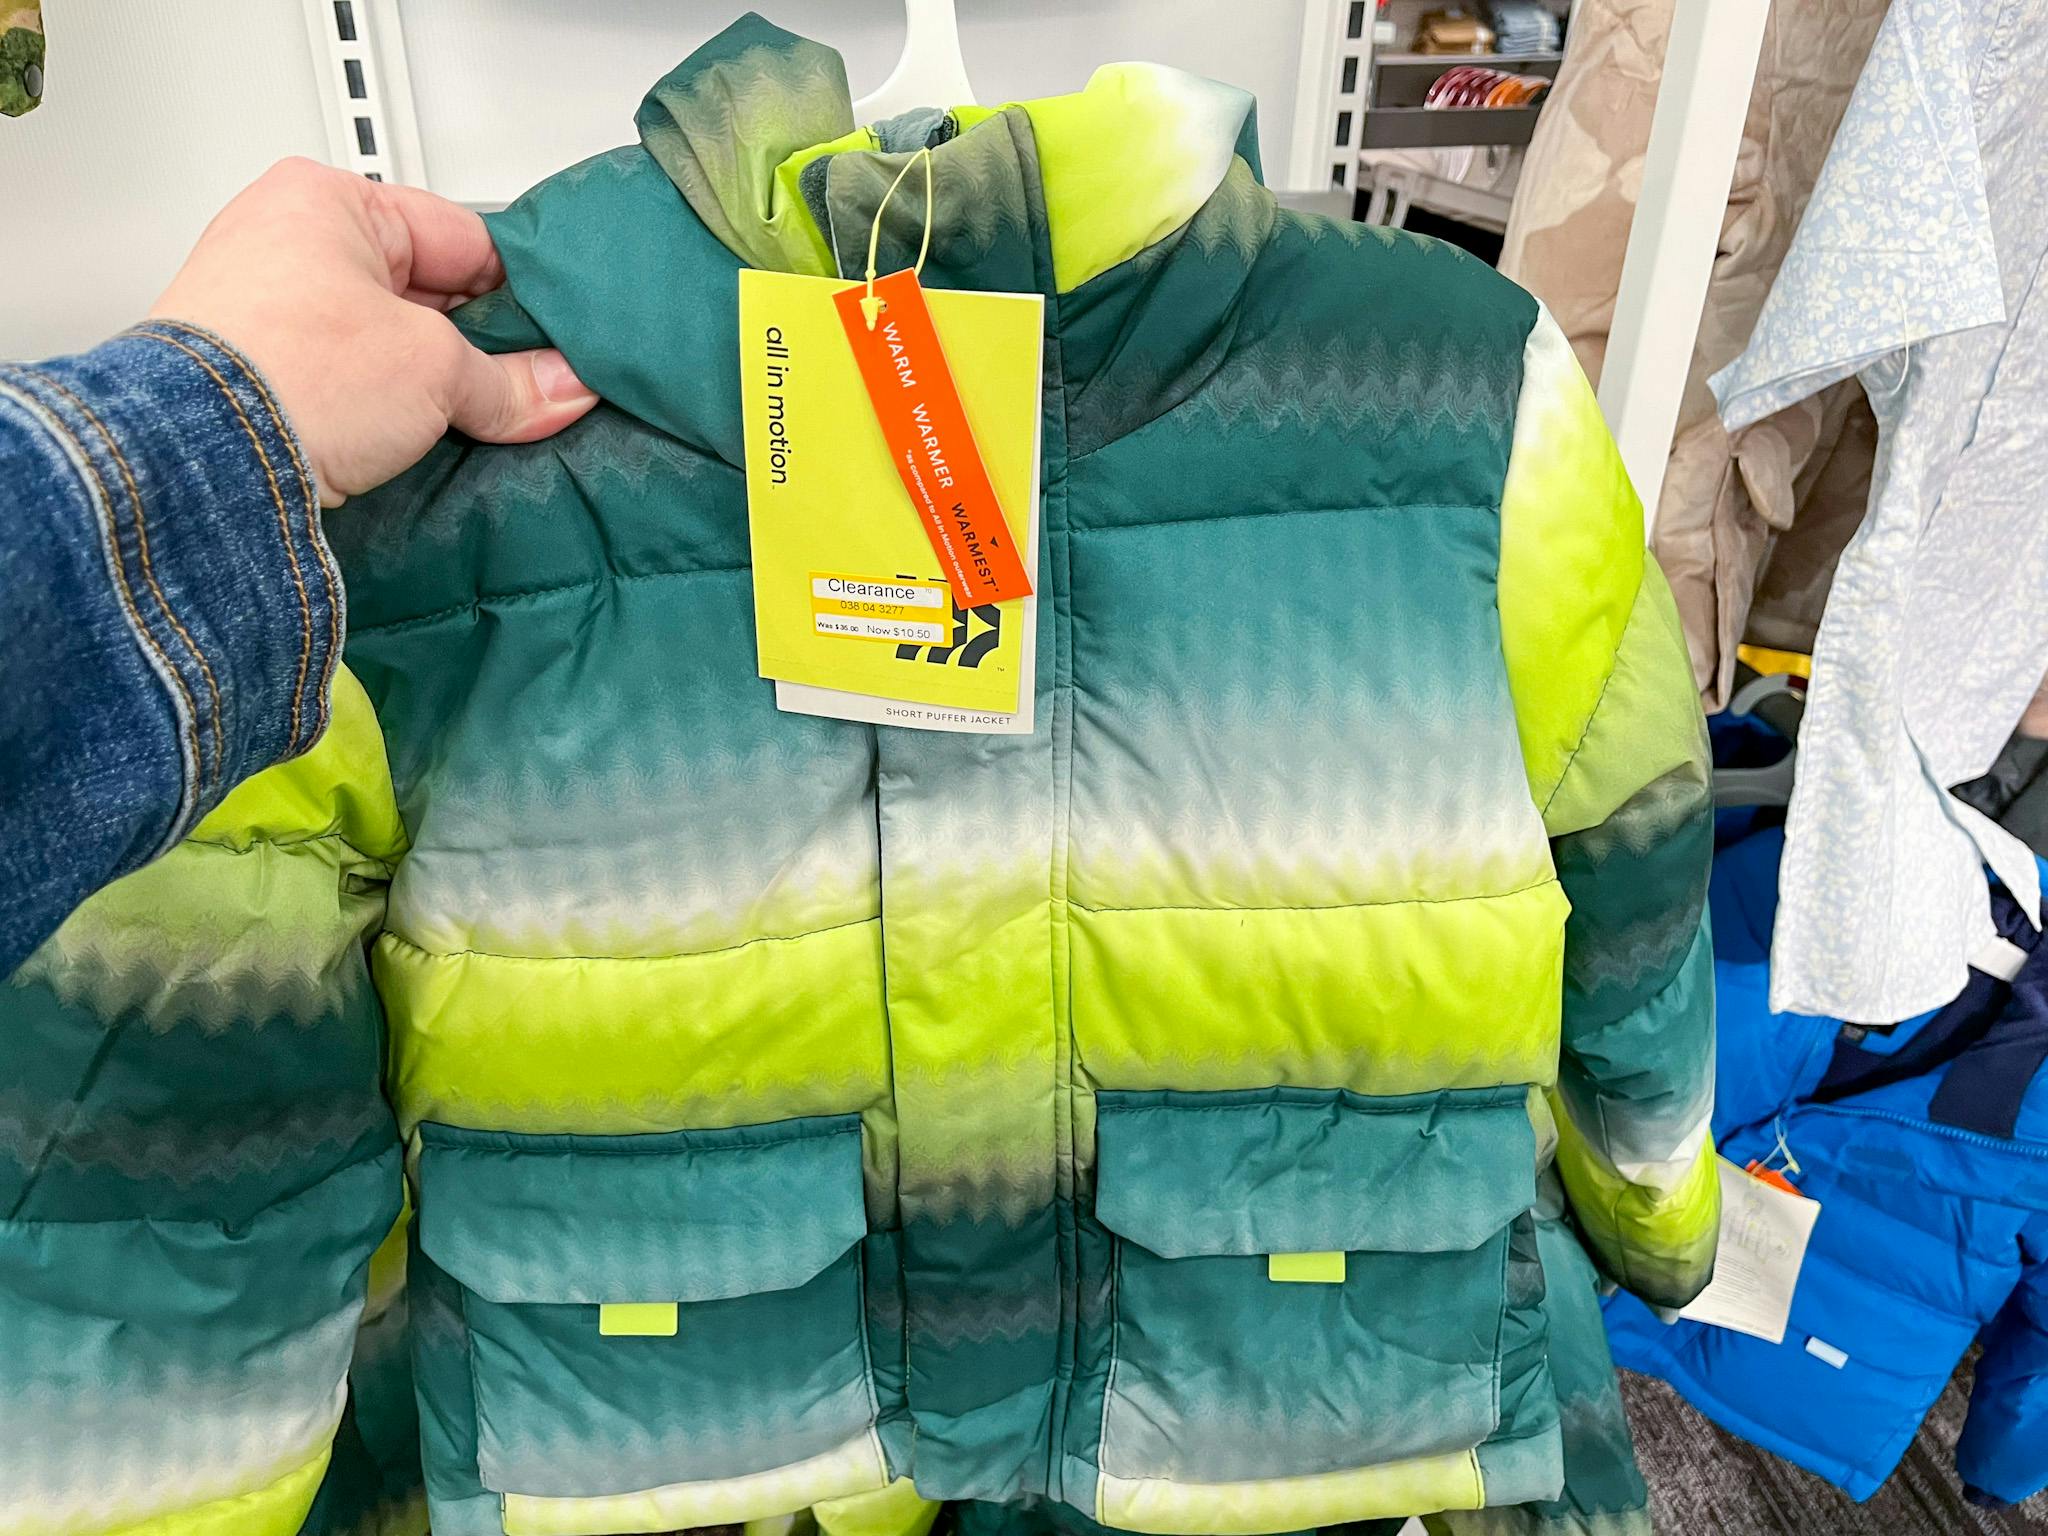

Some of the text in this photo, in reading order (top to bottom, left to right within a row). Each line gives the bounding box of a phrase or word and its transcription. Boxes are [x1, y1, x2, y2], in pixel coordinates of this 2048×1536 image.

[766, 327, 791, 484] all in motion
[882, 321, 916, 388] WARM
[912, 402, 954, 489] WARMER
[910, 464, 932, 505] compared
[929, 505, 936, 514] to
[932, 514, 943, 526] All
[941, 533, 956, 560] Motion
[828, 578, 915, 599] Clearance
[953, 560, 973, 598] outerwear
[840, 600, 905, 616] 038 04 3277
[817, 621, 833, 630] Was
[867, 625, 890, 636] Now
[886, 707, 1011, 725] SHORT PUFFER JACKET
